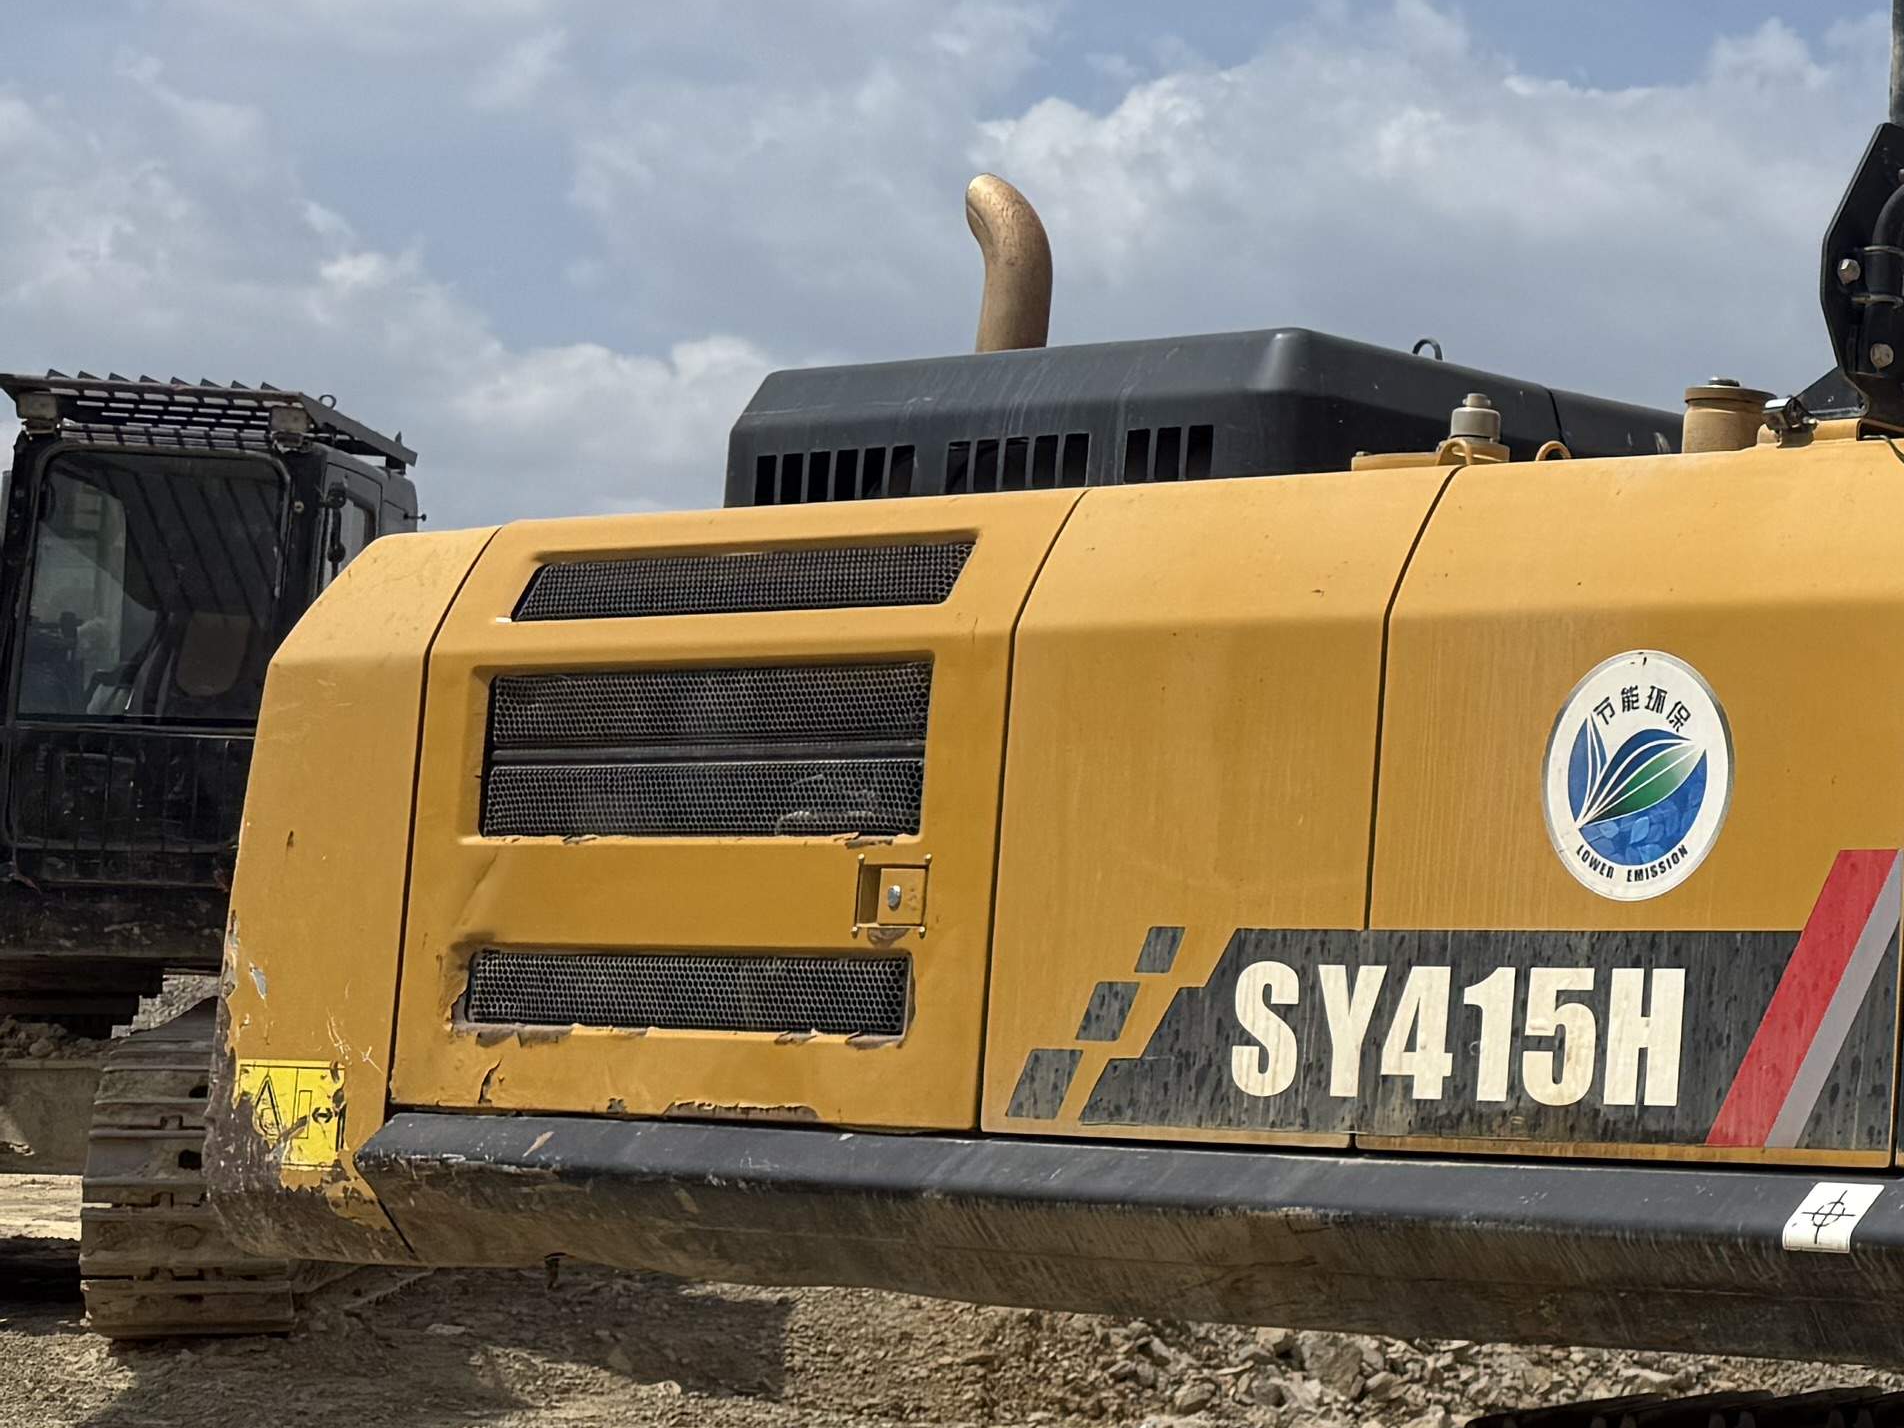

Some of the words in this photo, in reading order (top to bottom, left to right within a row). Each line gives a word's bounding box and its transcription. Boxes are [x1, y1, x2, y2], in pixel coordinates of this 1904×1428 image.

[1592, 684, 1692, 733] 节能环保
[1575, 843, 1615, 880] LOWER
[1625, 843, 1689, 883] EMISSION
[1229, 959, 1687, 1108] SY415H
